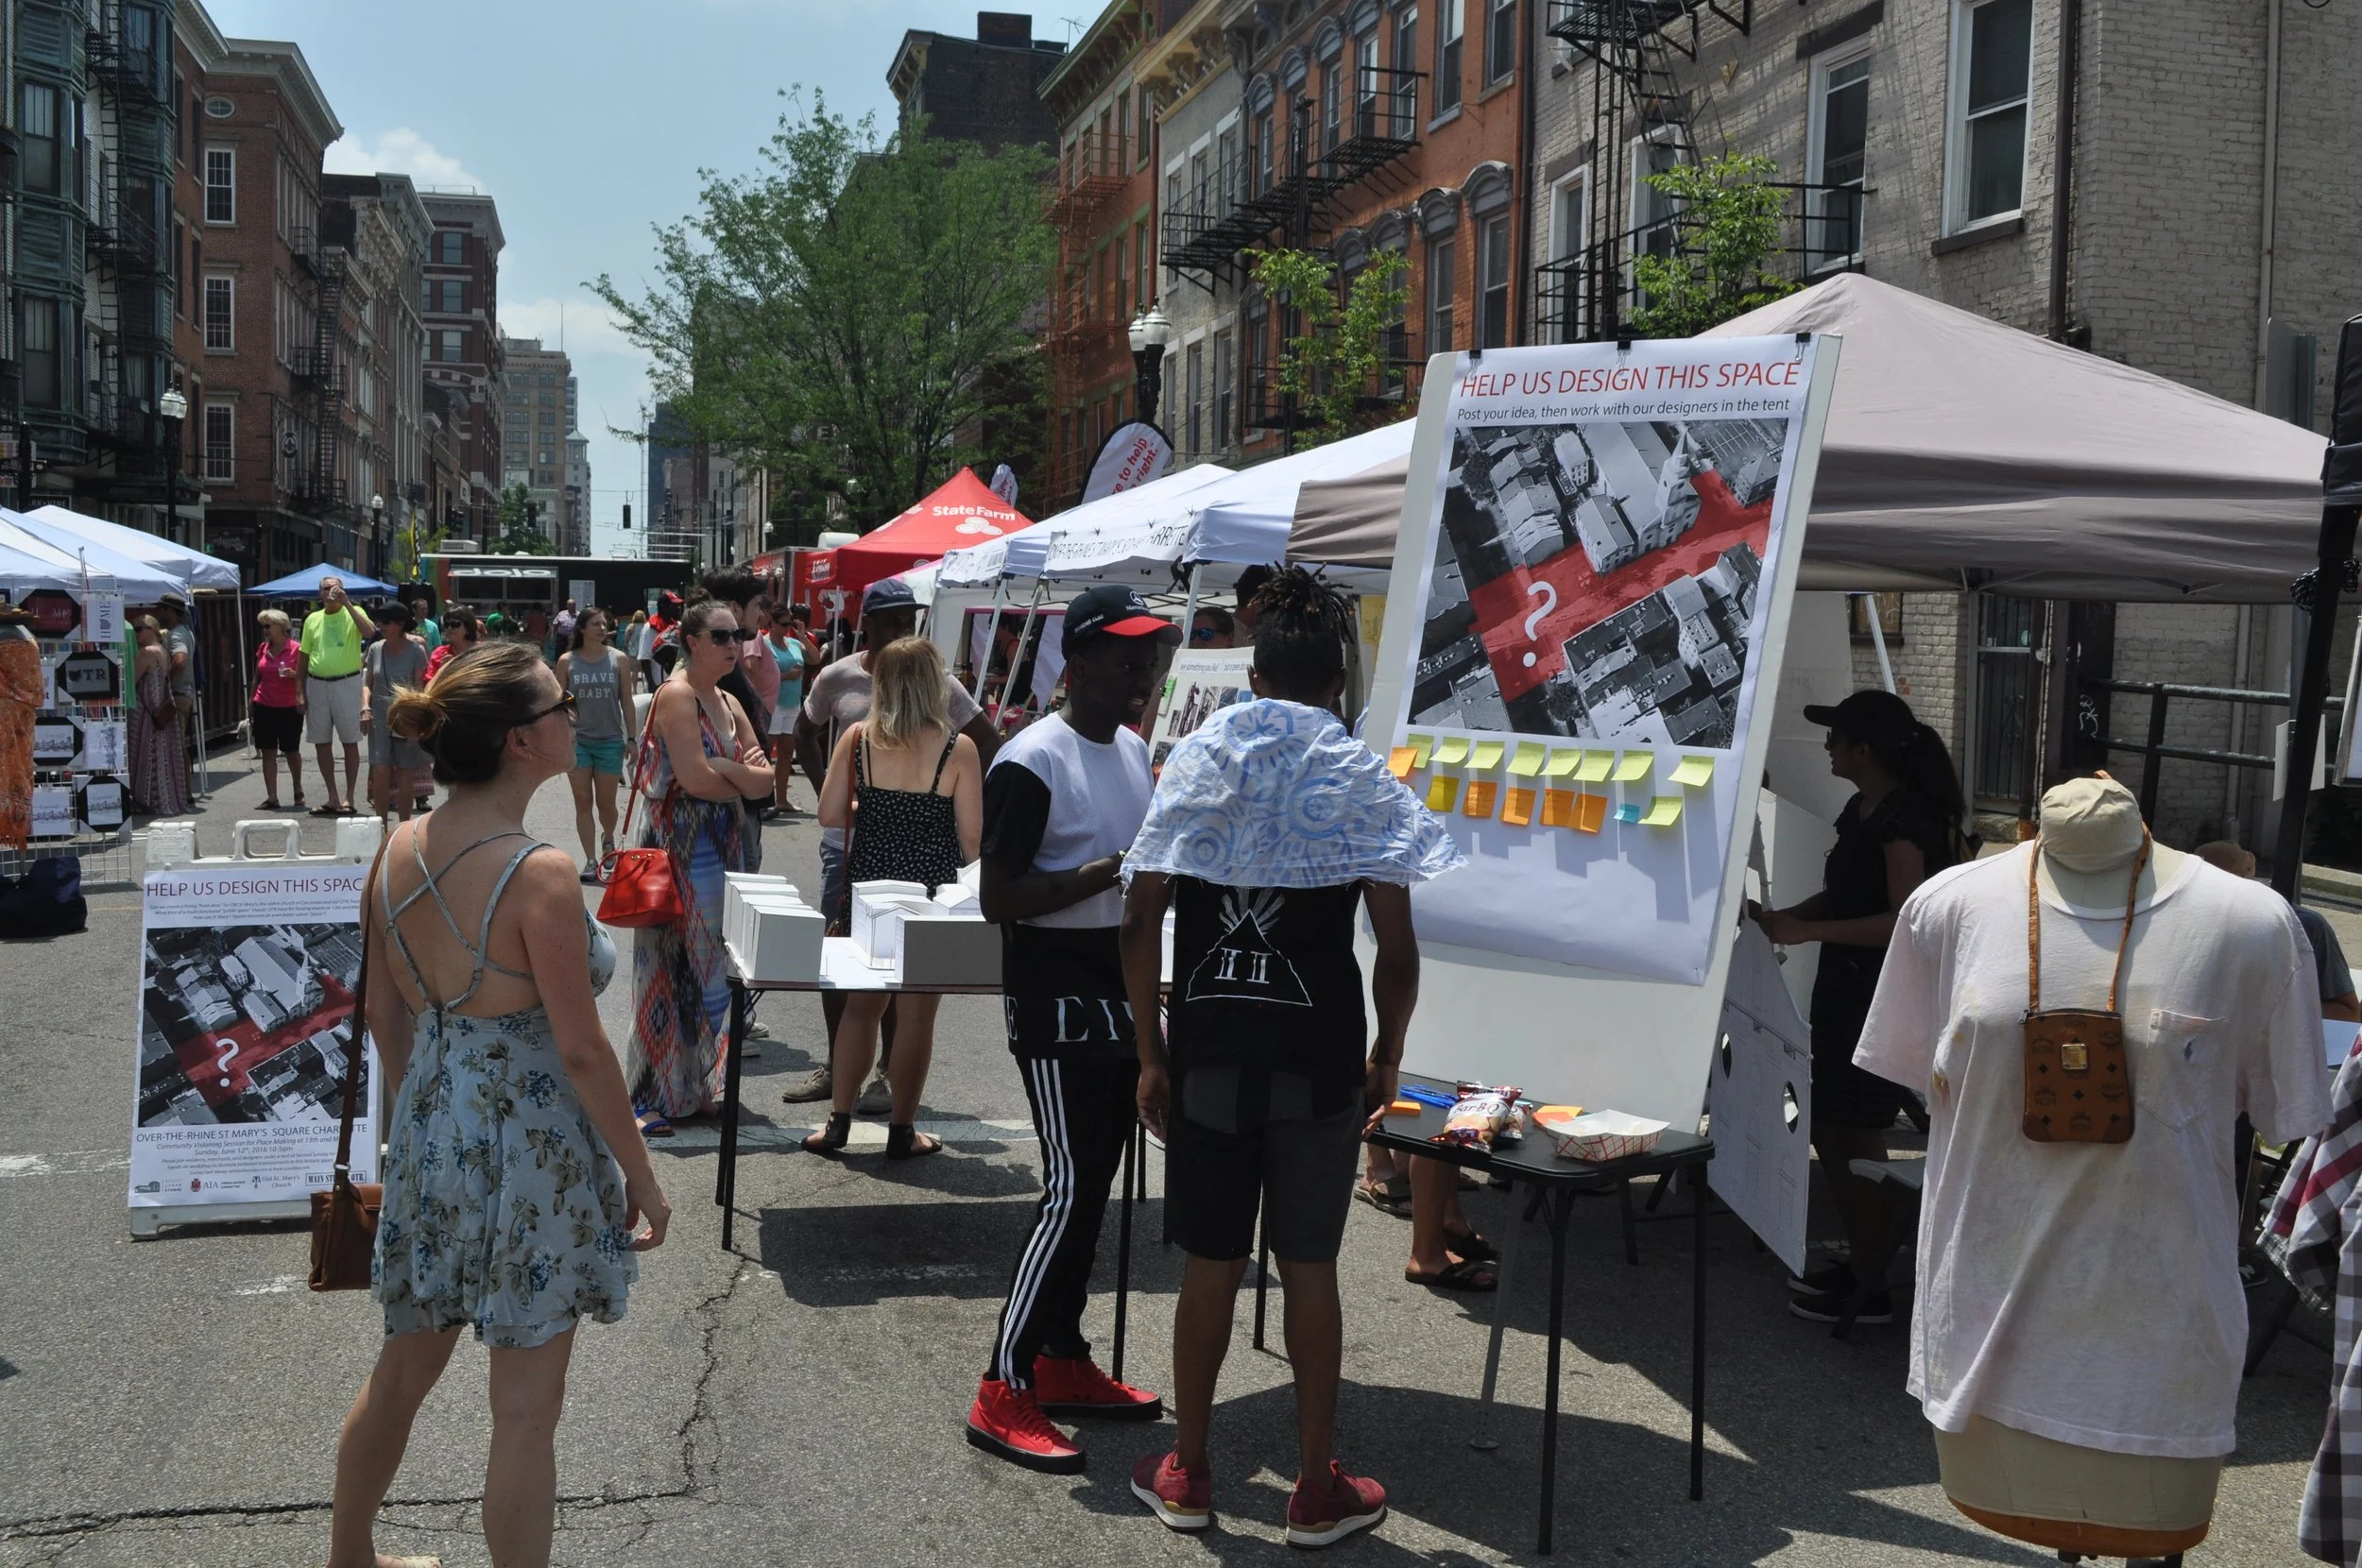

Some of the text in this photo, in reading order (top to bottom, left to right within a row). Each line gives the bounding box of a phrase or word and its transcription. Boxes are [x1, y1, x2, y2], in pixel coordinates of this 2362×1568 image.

[1460, 362, 1801, 398] HELP US DESIGN THIS SPACE
[1458, 398, 1790, 422] Post your idea, then work with our designers in the tent
[1119, 467, 1131, 481] to
[1126, 437, 1147, 466] help
[1136, 448, 1158, 482] right.
[573, 673, 615, 684] BRAVE
[578, 688, 611, 699] BABY
[147, 878, 363, 896] HELP US DESIGN THIS SPAC
[136, 1124, 368, 1142] OVER-THE-RHINE ST MARY'S SQUARE CHARTE
[158, 1142, 193, 1150] Community
[195, 1140, 222, 1149] Visioning
[274, 1136, 297, 1145] Making
[195, 1148, 220, 1156] Sunday,
[253, 1145, 267, 1153] 2016
[202, 1180, 219, 1189] AIA
[308, 1175, 324, 1184] MAIN
[351, 1173, 364, 1182] OTR
